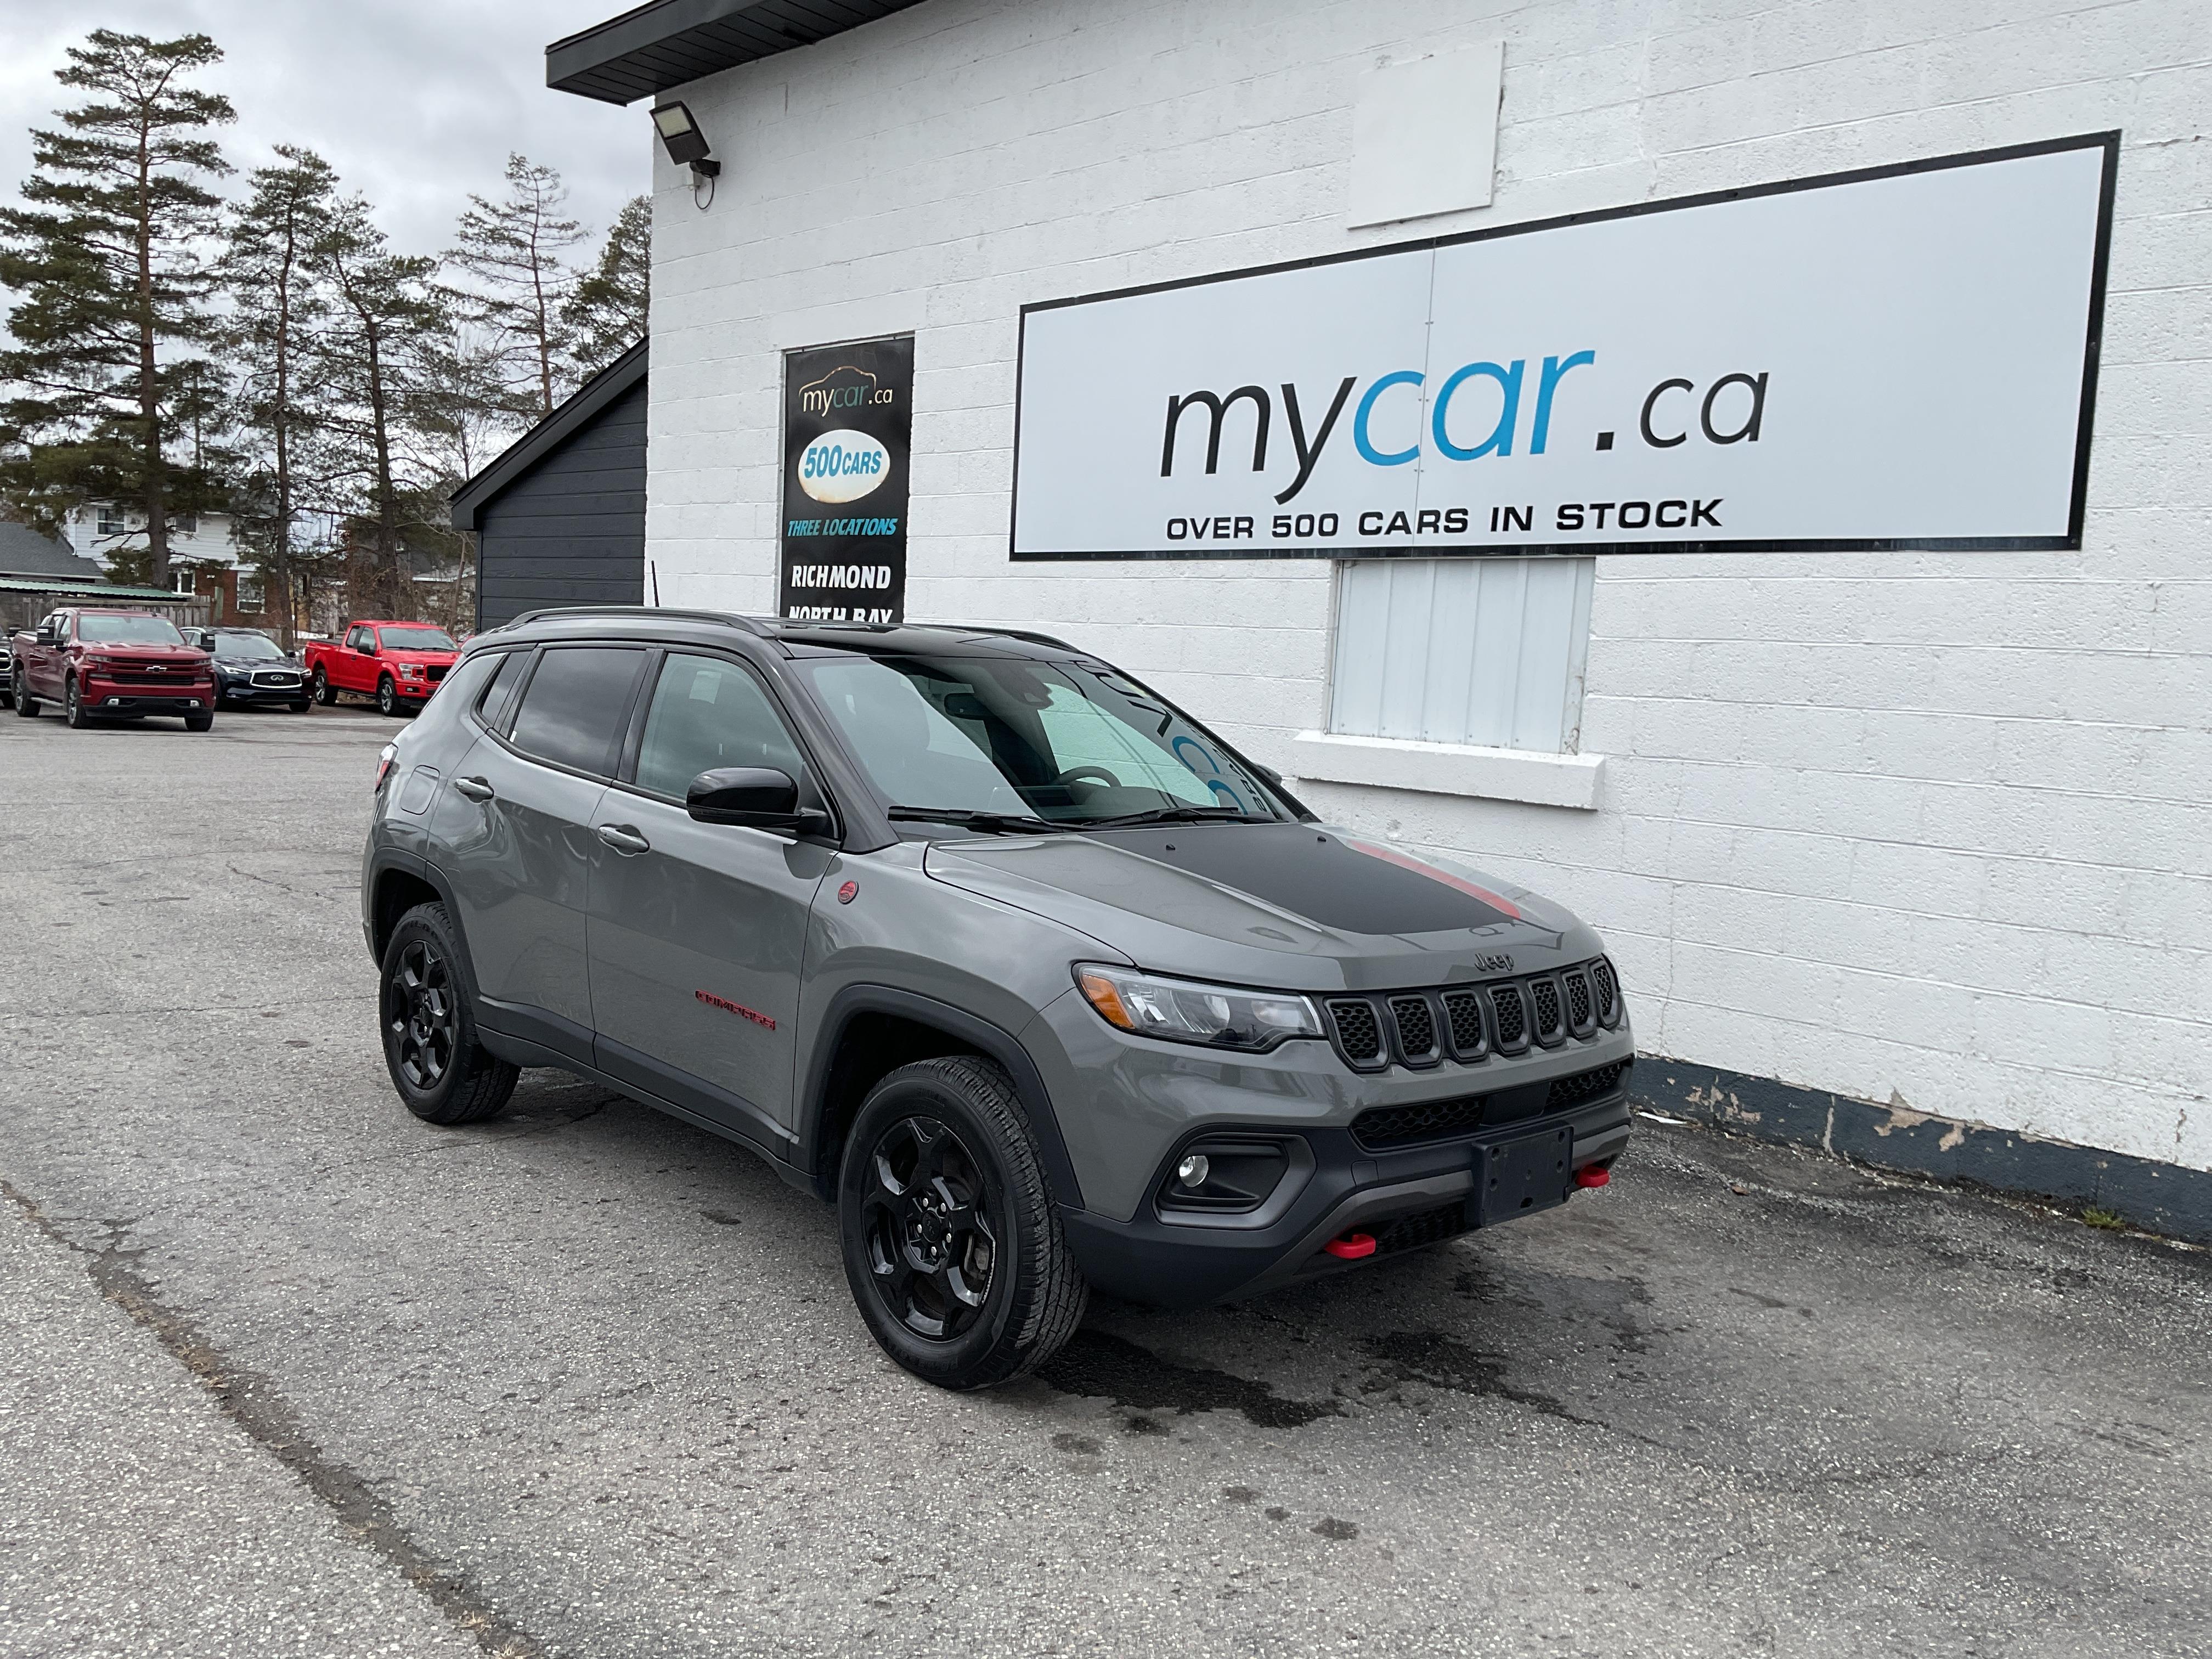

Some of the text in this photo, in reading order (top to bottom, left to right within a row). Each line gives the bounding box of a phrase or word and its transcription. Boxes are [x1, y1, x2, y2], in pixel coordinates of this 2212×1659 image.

[803, 384, 893, 417] mycar.ca
[1160, 350, 1769, 506] mycar.ca
[787, 517, 899, 538] THREE LOCATIONS
[1166, 498, 1724, 540] OVER 500 CARS IN STOCK
[791, 565, 891, 589] RICHMOND
[853, 608, 893, 624] BAY
[1474, 952, 1514, 972] Jeep
